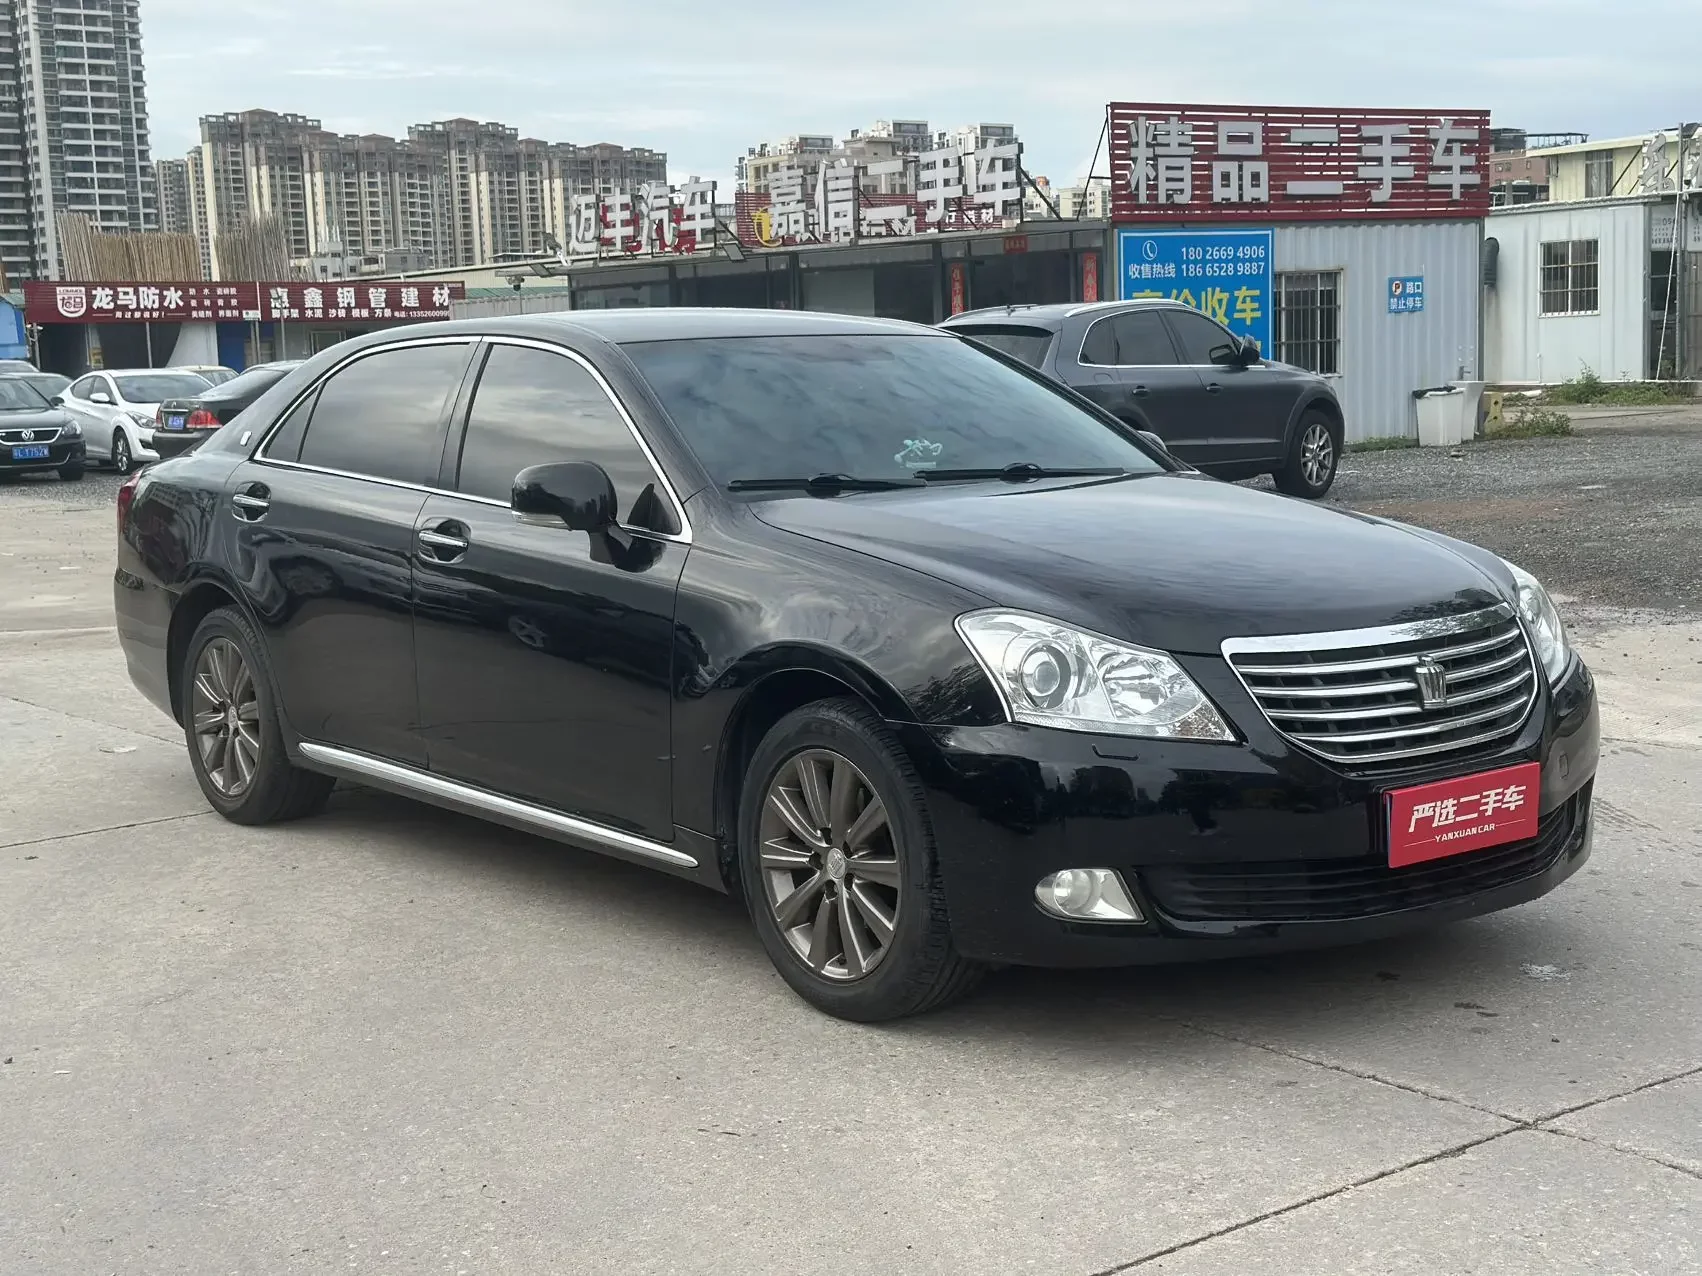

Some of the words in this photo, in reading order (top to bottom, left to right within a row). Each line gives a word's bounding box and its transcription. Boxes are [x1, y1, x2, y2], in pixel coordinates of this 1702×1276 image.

[1128, 116, 1481, 204] 精品二手车
[767, 138, 1022, 239] 嘉信二手车
[1182, 247, 1203, 260] 180
[1206, 247, 1233, 259] 2669
[1237, 246, 1265, 258] 4906
[1129, 262, 1176, 279] 收售热线
[1182, 264, 1203, 277] 186
[1206, 264, 1233, 276] 6528
[1237, 262, 1265, 275] 9887
[92, 286, 184, 309] 龙马防水
[1408, 784, 1527, 833] 严选二手车
